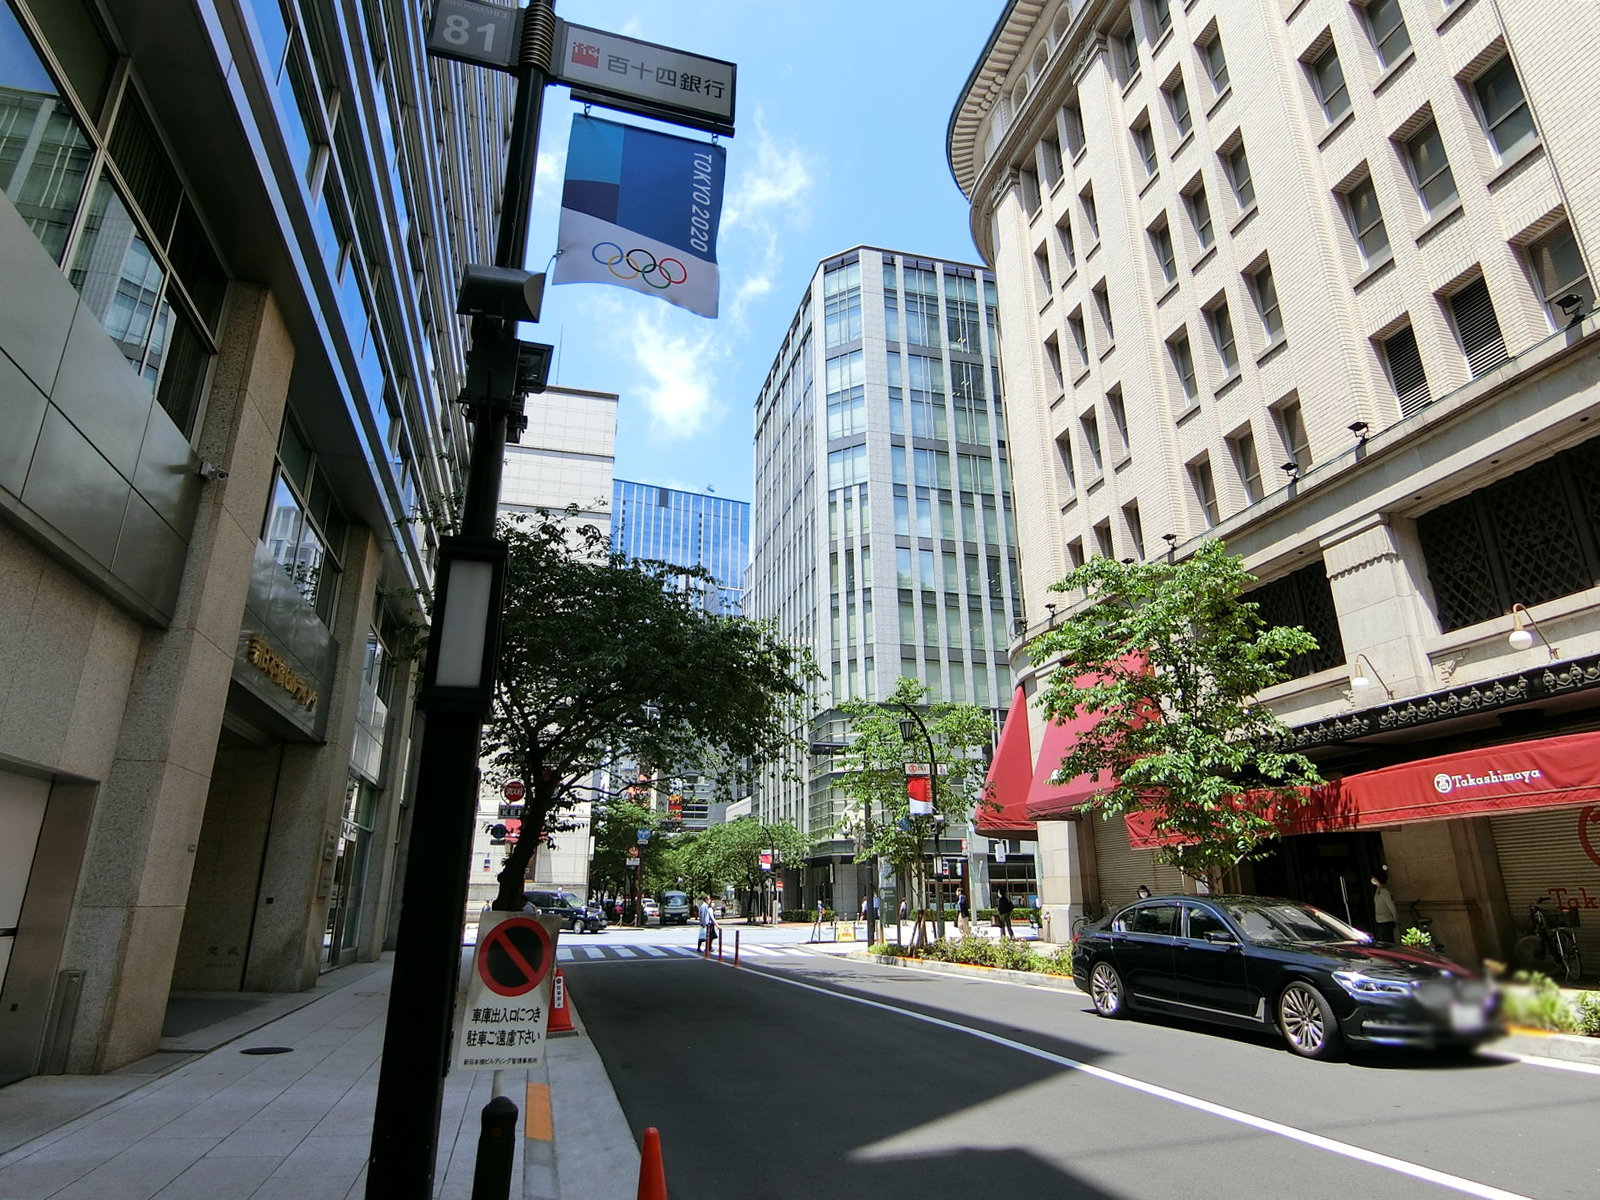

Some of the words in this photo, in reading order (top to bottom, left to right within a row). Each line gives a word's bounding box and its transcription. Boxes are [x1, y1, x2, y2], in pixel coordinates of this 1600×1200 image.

[442, 14, 497, 53] 81
[607, 53, 726, 99] 百十四銀行
[693, 152, 712, 206] TOKYO
[690, 205, 709, 253] 2020
[1451, 769, 1541, 788] Takashimaya
[471, 1007, 541, 1024] 車庫出入口につき
[466, 1029, 541, 1047] 駐車ご遠慮下さい
